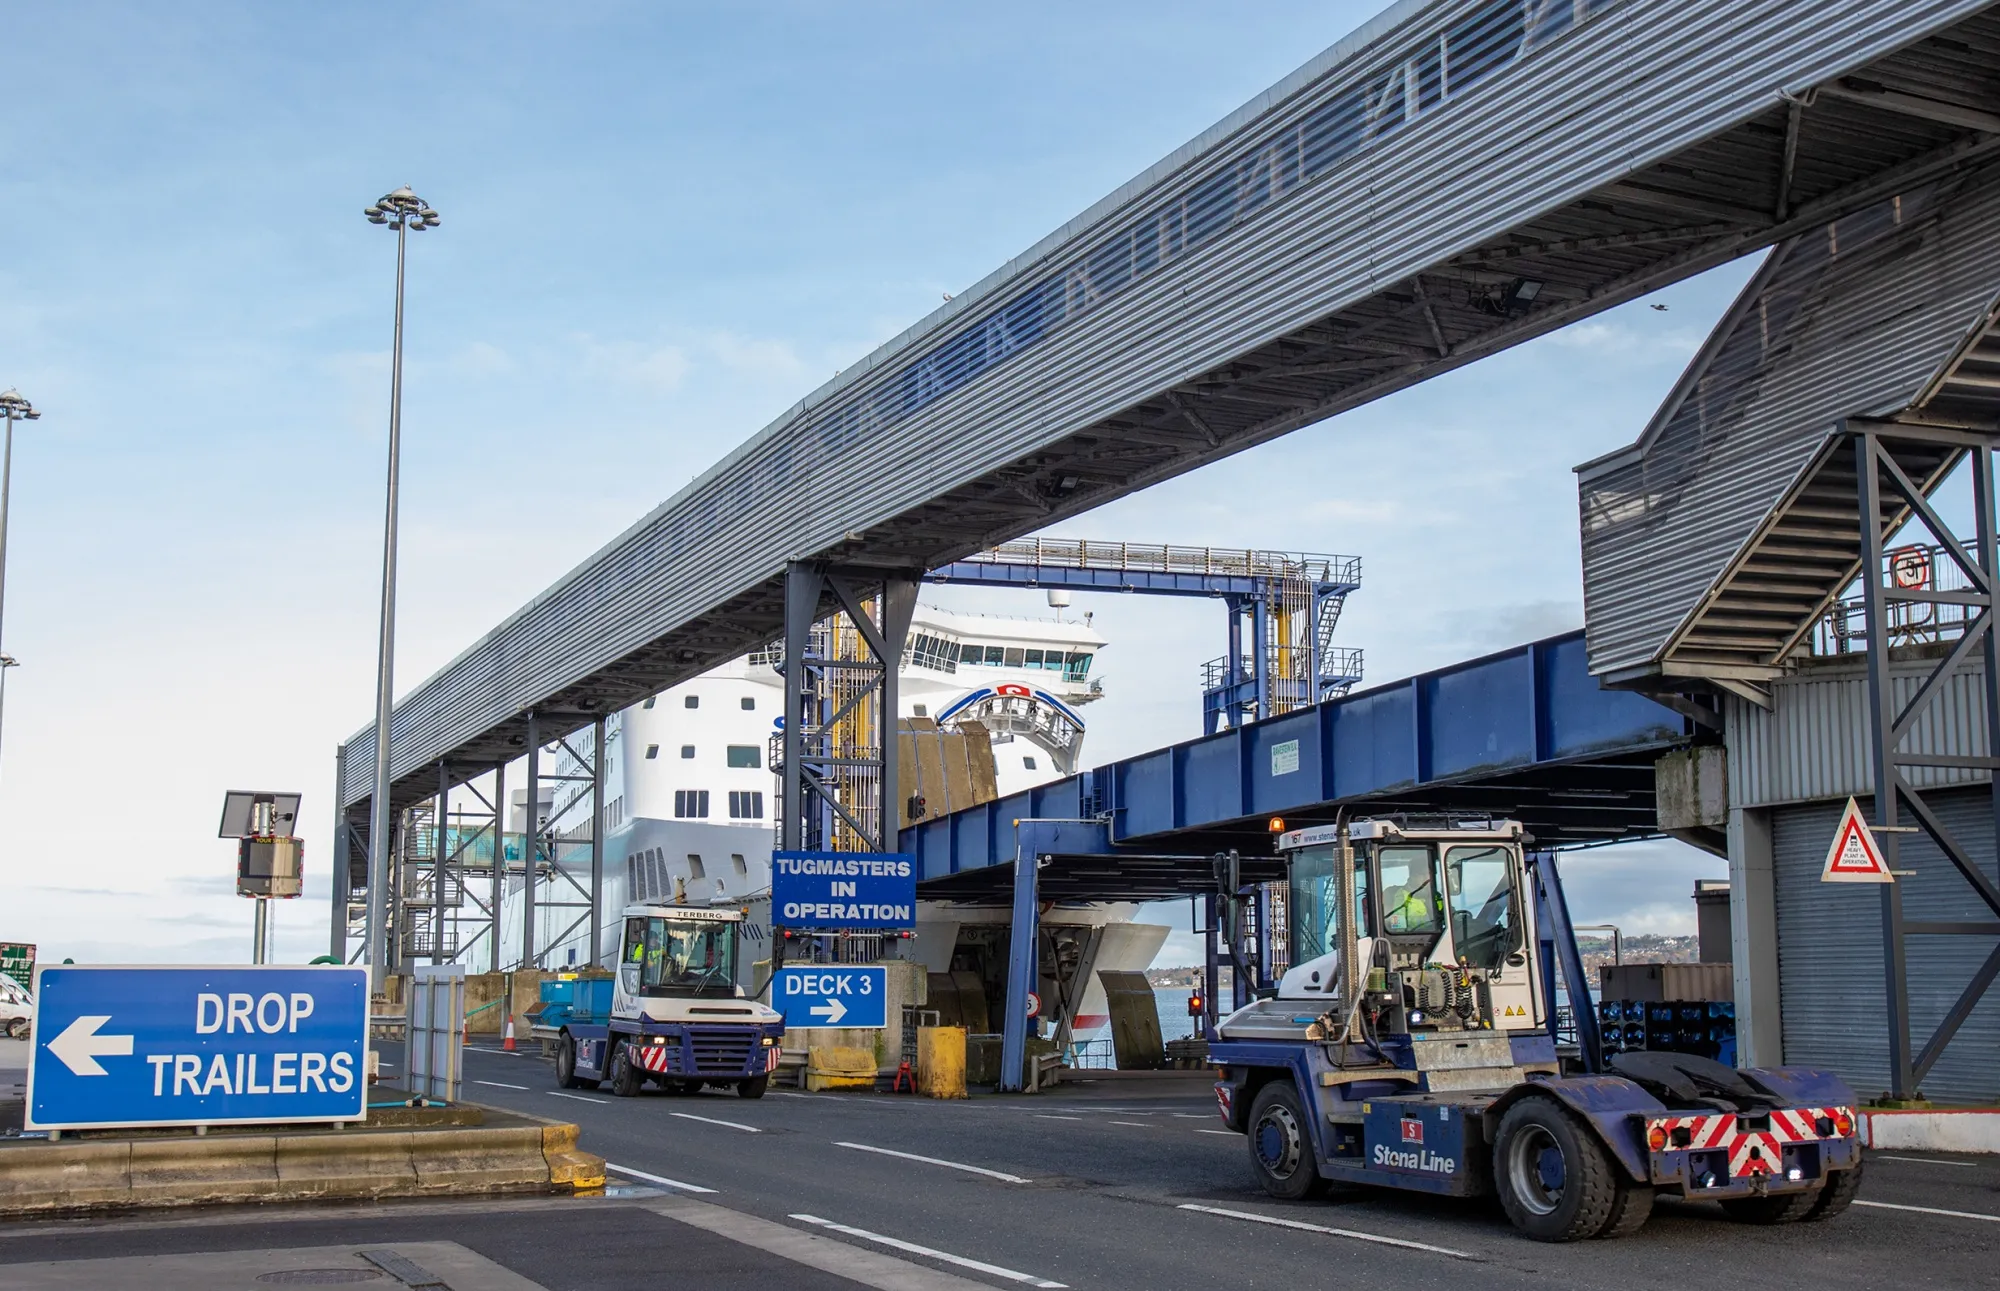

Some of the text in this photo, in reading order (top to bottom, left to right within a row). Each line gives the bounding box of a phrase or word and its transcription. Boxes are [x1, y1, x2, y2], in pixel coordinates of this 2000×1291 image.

[776, 858, 911, 877] TUGMASTERS
[831, 881, 856, 897] IN
[676, 911, 723, 919] TERBERG
[783, 902, 910, 920] OPERATION
[785, 974, 872, 995] DECK 3
[195, 992, 314, 1034] DROP
[146, 1051, 354, 1097] TRAILERS
